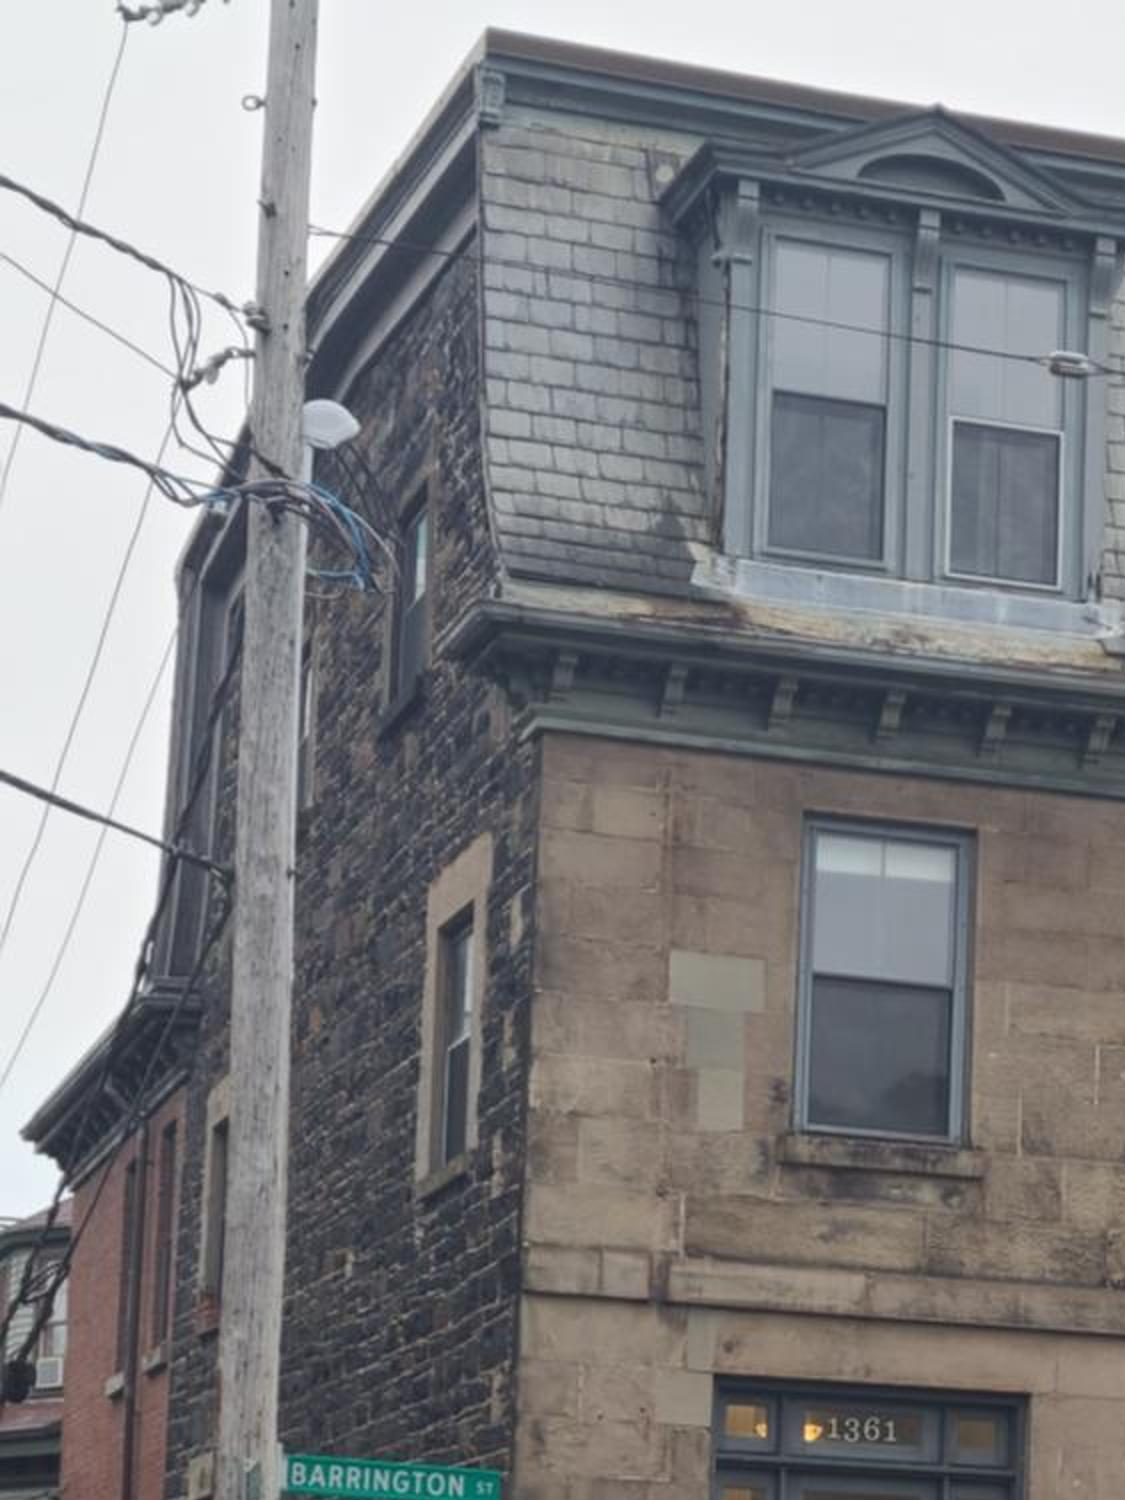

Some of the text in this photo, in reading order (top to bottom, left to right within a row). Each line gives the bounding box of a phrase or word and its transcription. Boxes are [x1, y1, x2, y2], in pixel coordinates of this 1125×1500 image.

[827, 1416, 896, 1443] 1361
[290, 1462, 494, 1497] BARRINGTON ST
